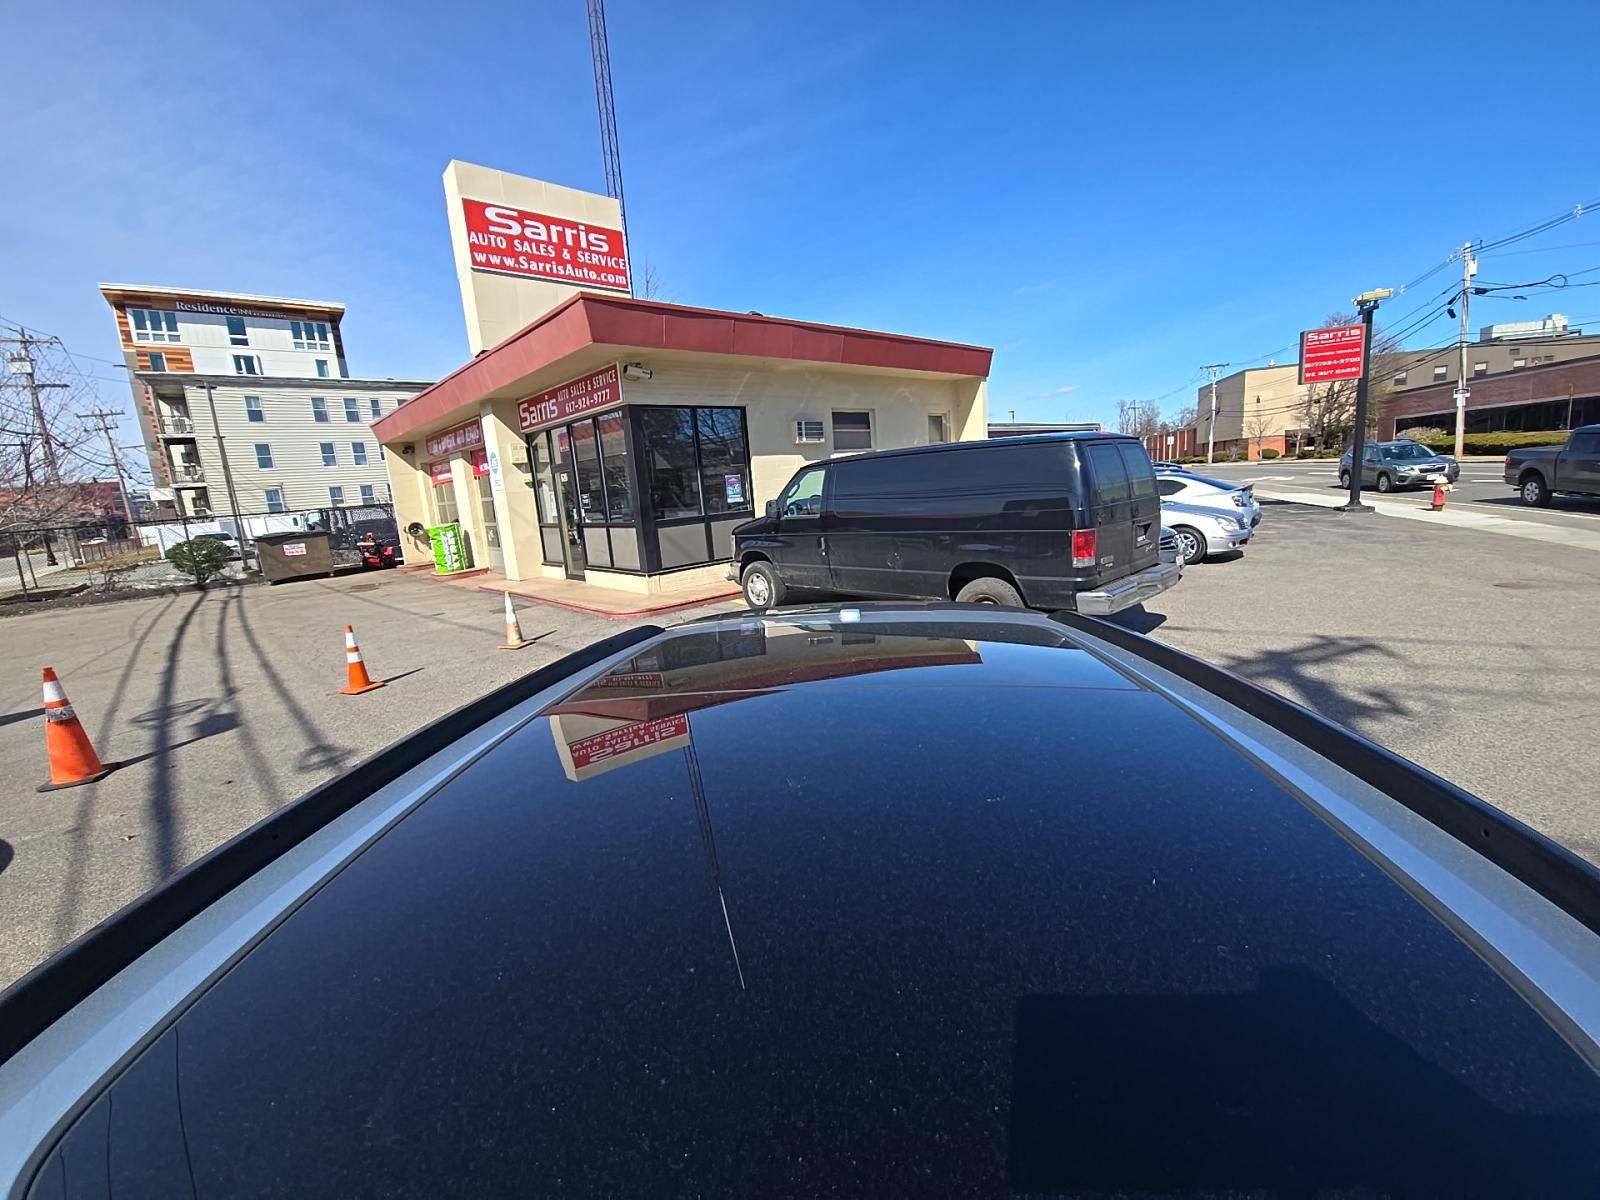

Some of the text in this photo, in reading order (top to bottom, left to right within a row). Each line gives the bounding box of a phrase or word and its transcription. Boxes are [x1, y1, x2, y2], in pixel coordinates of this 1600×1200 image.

[484, 206, 609, 253] Sarris
[469, 231, 627, 270] AUTO SALES & SERVICE
[473, 251, 627, 285] www.SarrisAuto.com
[175, 301, 237, 315] Residence
[1307, 328, 1361, 342] Sarris
[557, 369, 616, 402] AUTO SALES & SERVICE
[519, 394, 558, 427] Sarris
